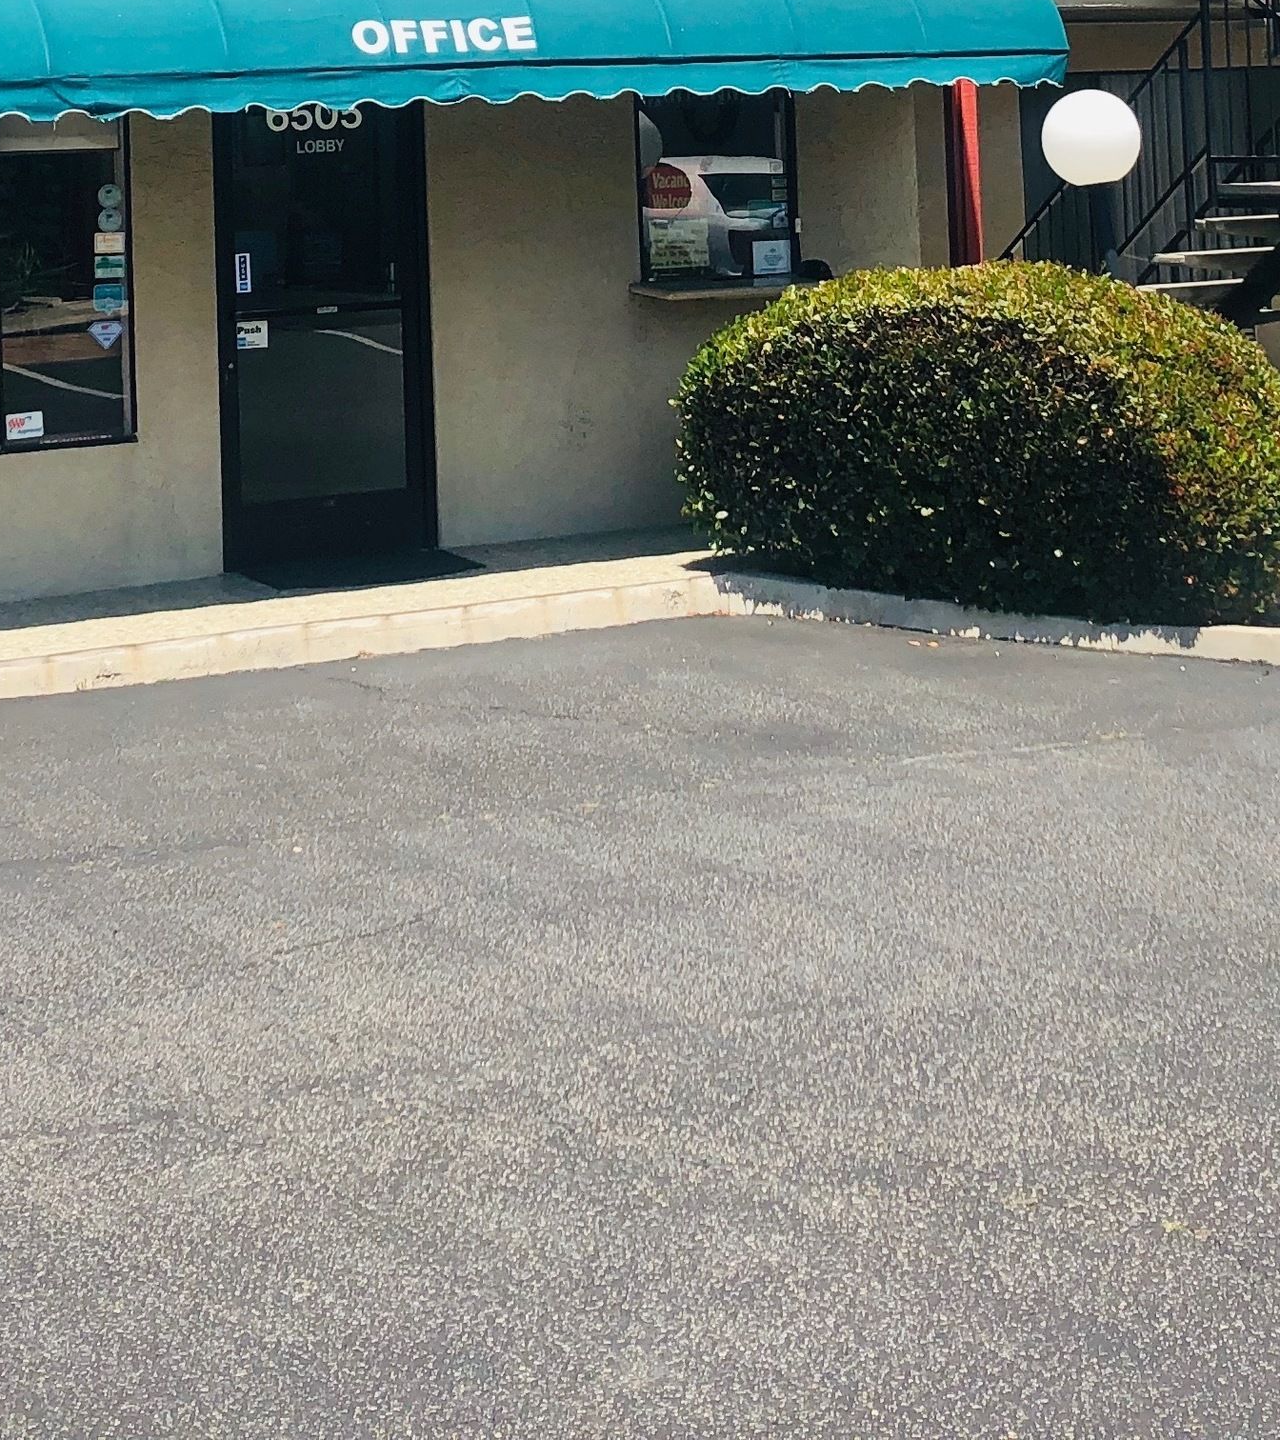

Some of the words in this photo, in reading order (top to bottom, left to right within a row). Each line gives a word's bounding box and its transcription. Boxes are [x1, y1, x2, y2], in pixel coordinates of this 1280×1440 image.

[351, 15, 538, 54] OFFICE
[296, 139, 345, 154] LOBBY
[236, 325, 262, 335] Push
